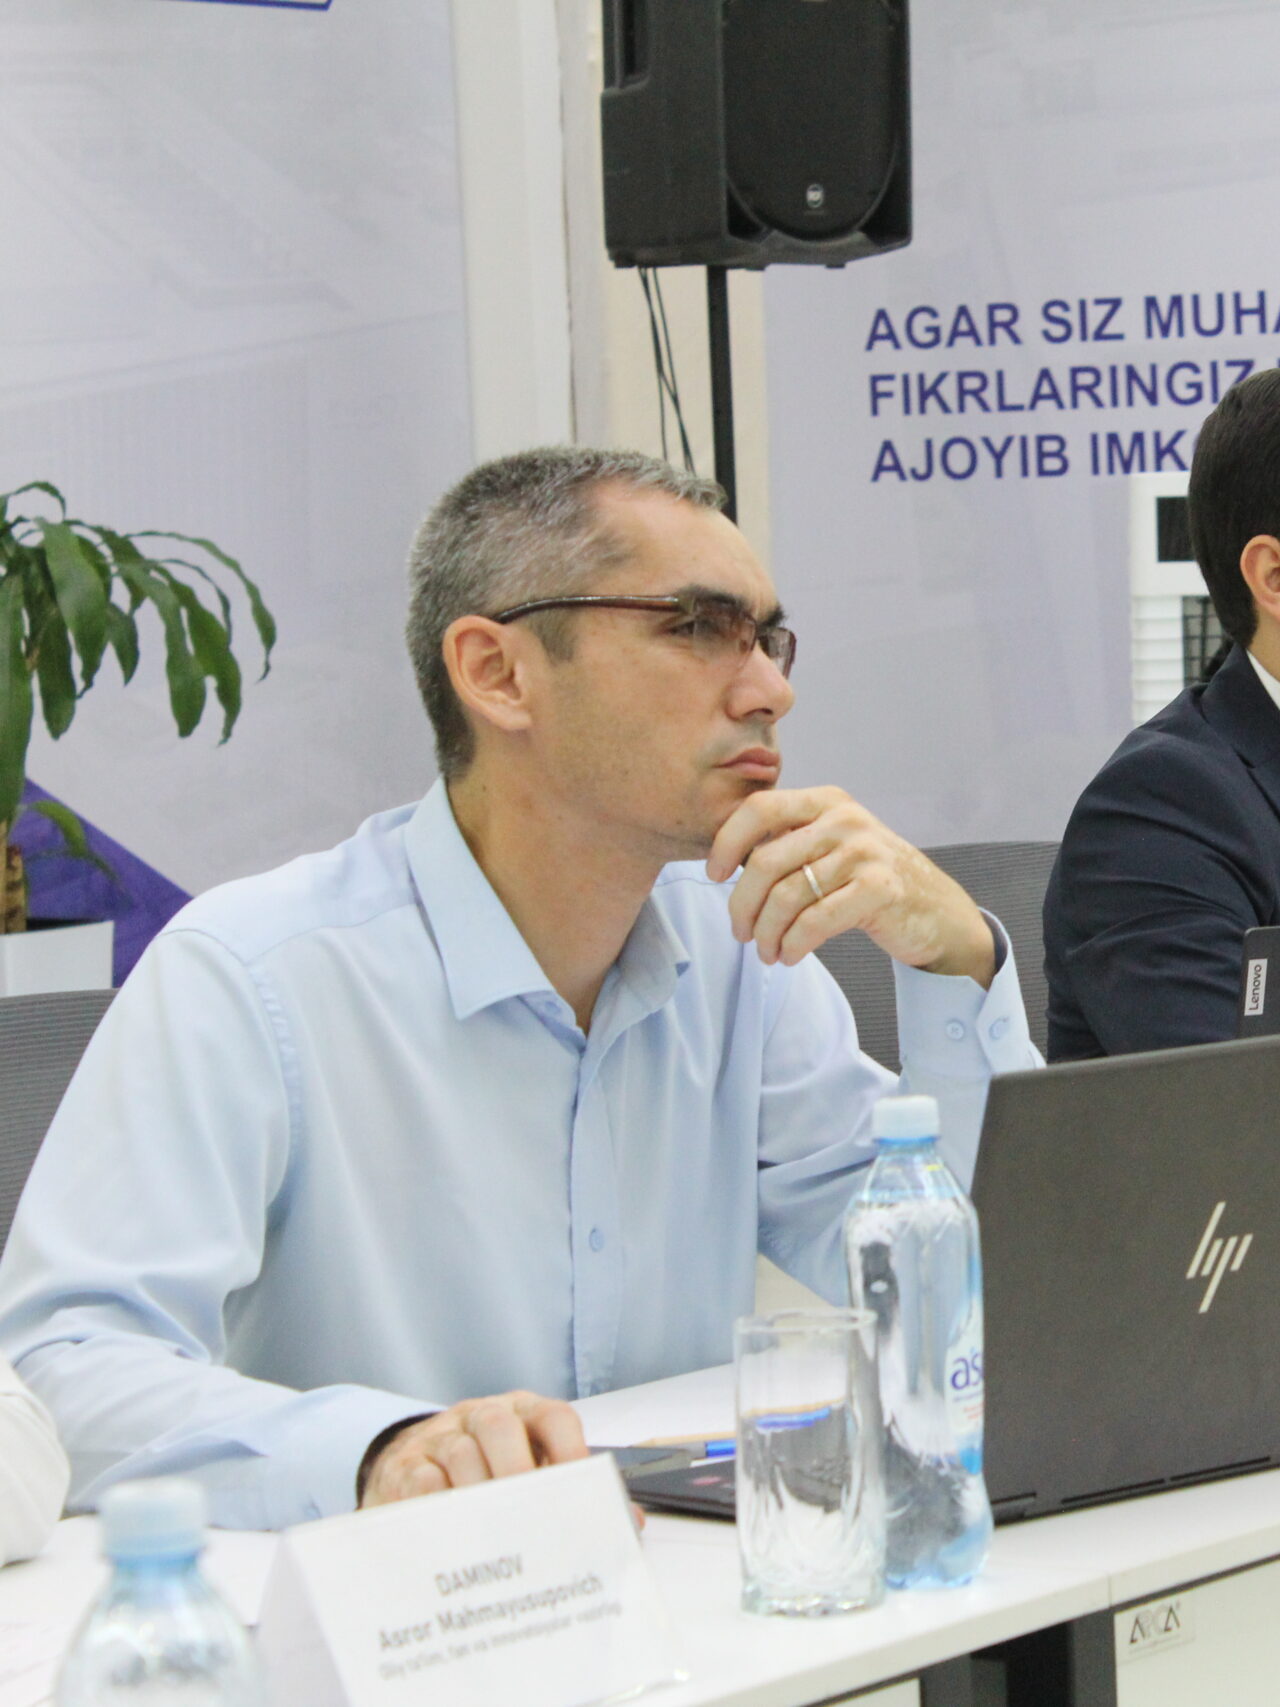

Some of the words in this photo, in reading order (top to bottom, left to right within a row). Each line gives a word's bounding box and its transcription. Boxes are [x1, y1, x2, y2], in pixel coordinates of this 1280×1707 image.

[867, 303, 1022, 351] AGAR
[1042, 297, 1125, 345] SIZ
[872, 434, 1070, 481] AJOYIB
[1248, 964, 1262, 1011] Lenovo
[434, 1553, 524, 1597] DAMINOV
[377, 1619, 434, 1652] Asror
